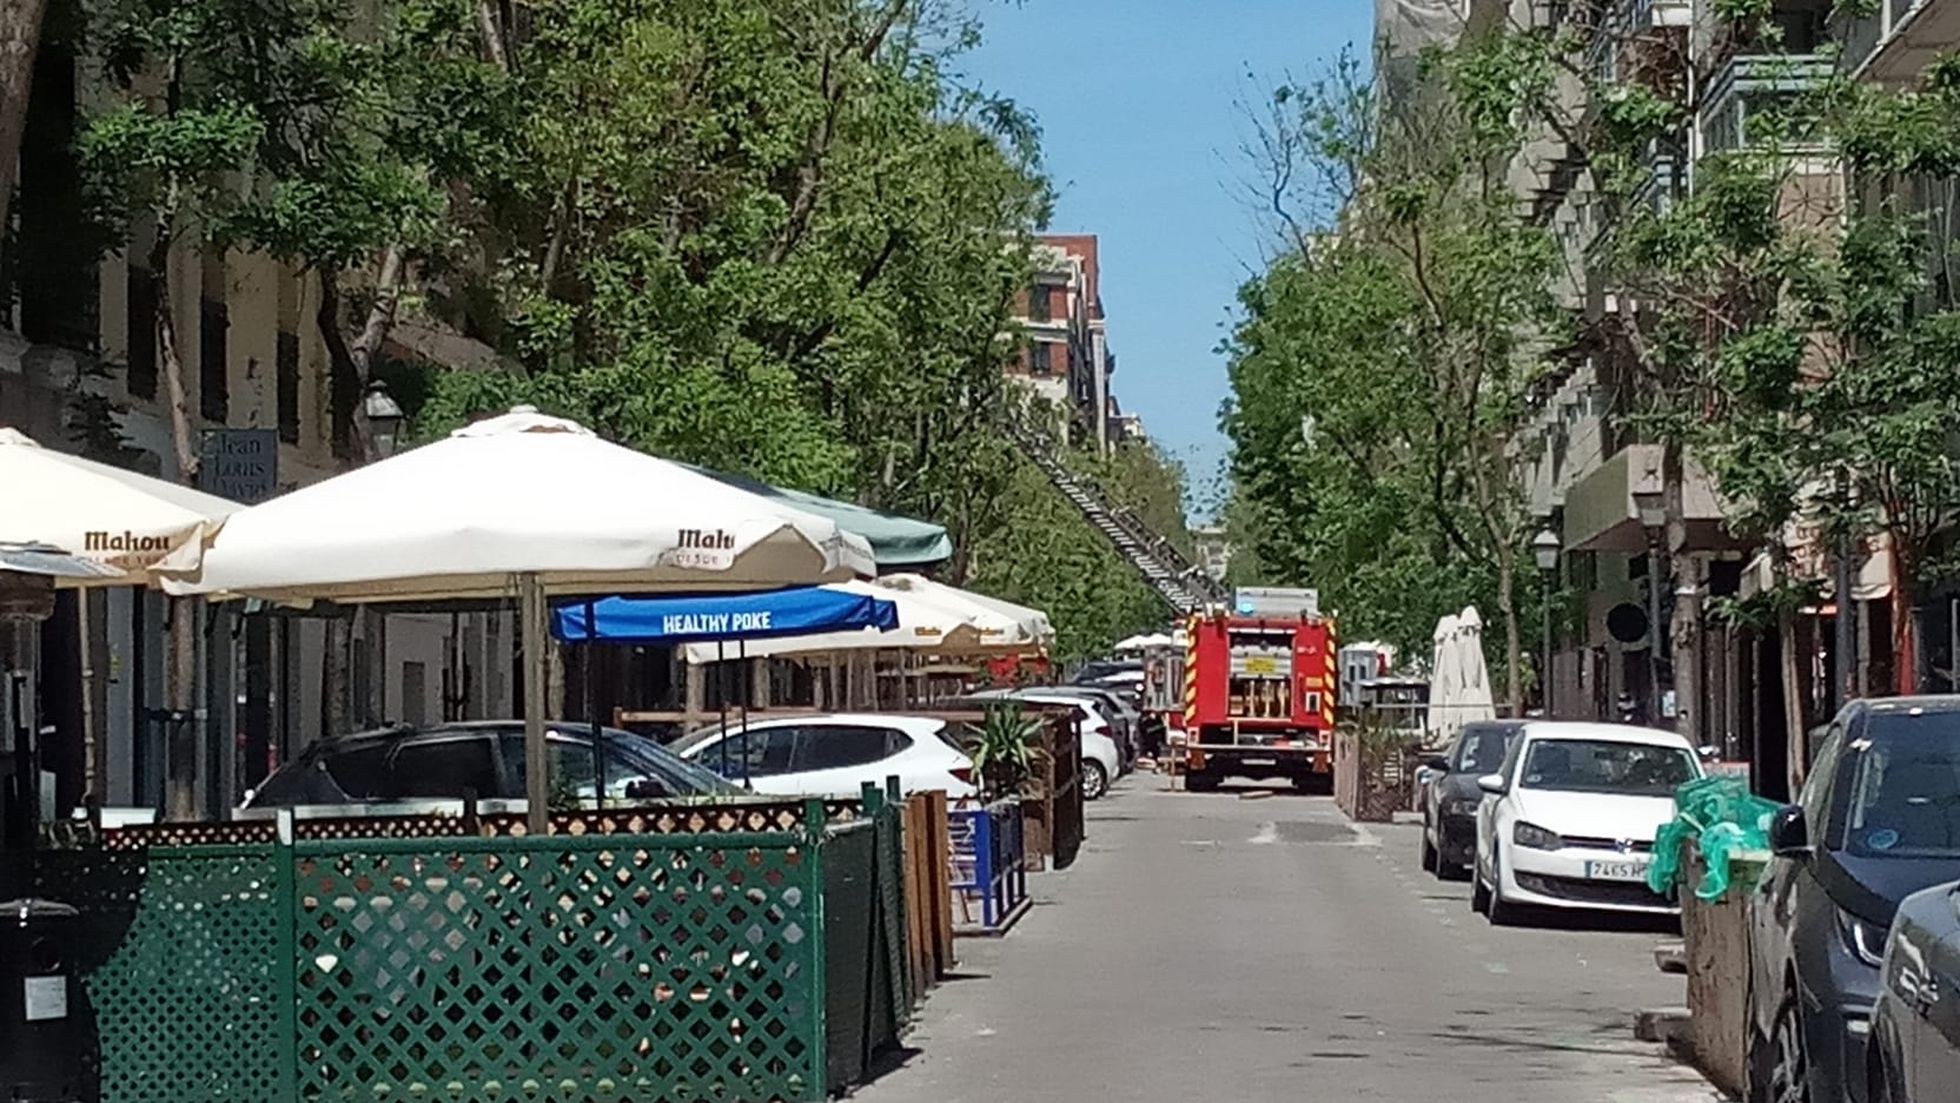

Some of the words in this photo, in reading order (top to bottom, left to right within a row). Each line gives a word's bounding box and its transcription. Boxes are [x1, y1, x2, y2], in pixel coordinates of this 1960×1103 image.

[84, 530, 169, 551] Mahou
[663, 613, 729, 634] HEALTHY
[732, 611, 772, 632] POKE
